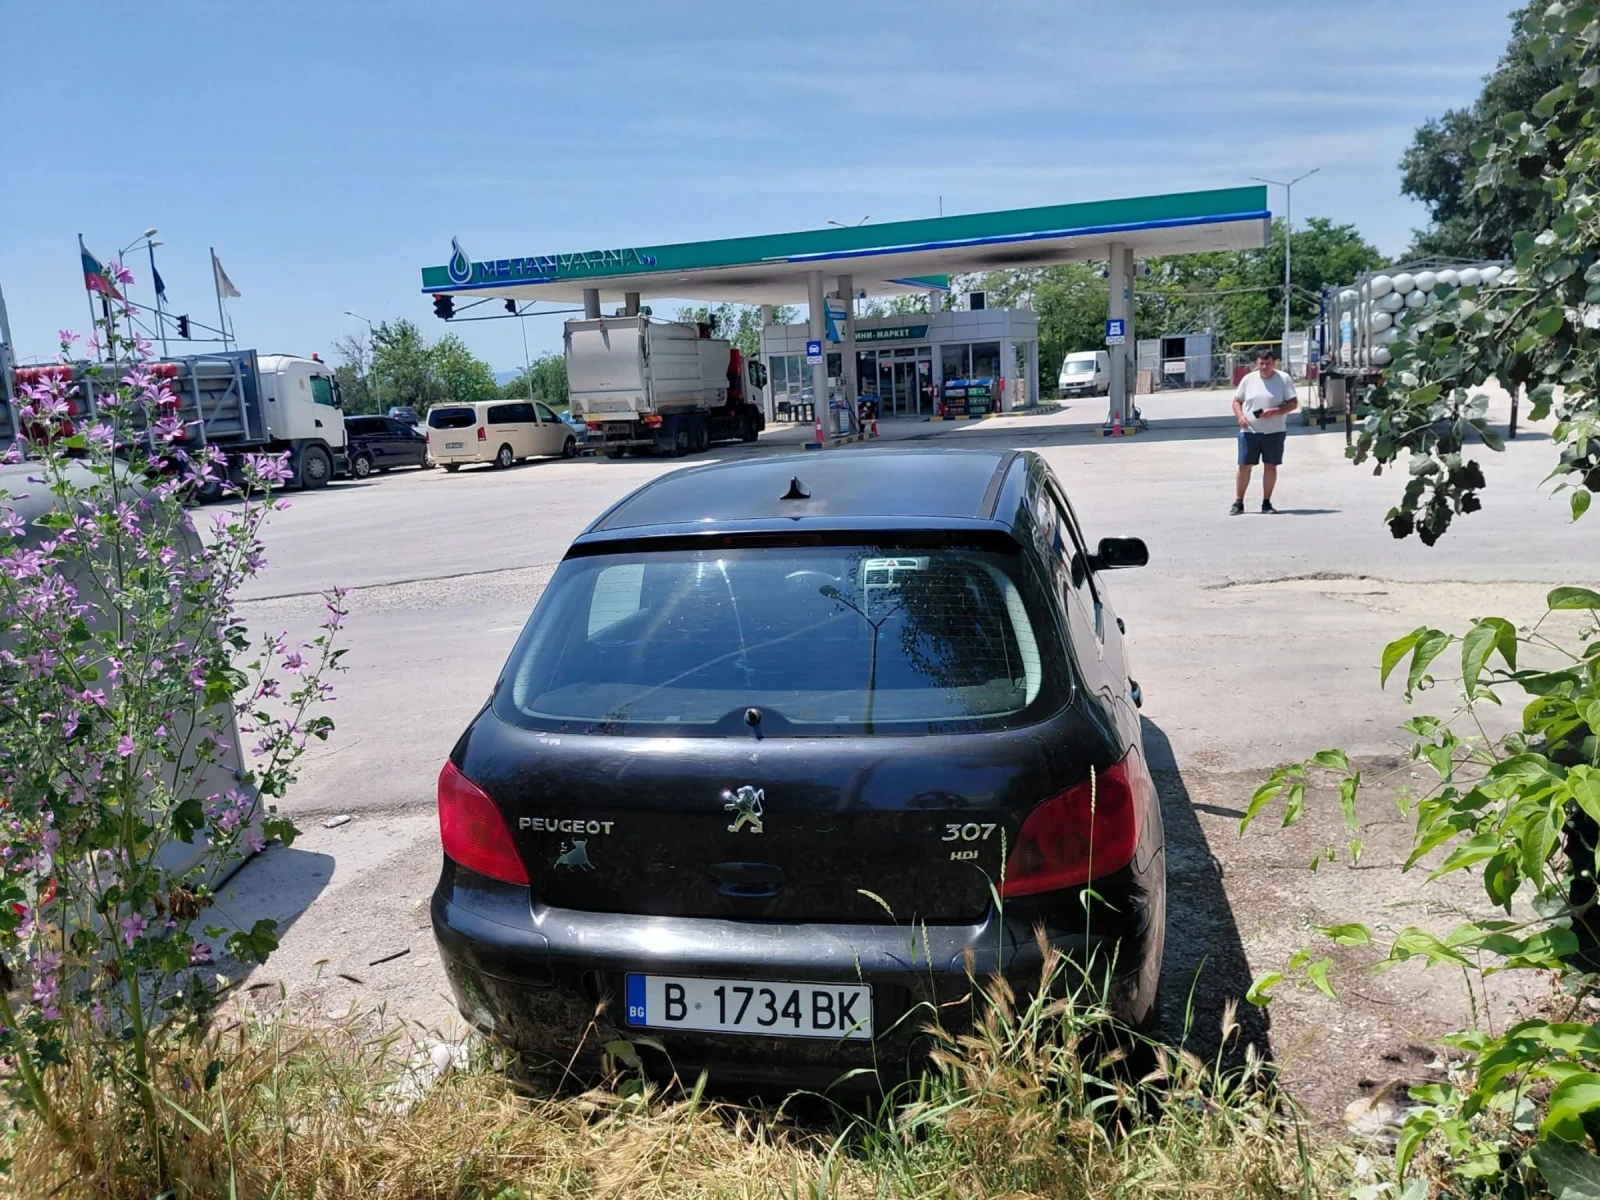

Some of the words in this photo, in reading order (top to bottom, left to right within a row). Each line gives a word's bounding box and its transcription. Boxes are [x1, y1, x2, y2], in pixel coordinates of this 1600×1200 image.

[518, 817, 615, 835] PEUGEOT
[941, 823, 997, 841] 307
[629, 1005, 645, 1018] BG
[664, 983, 688, 1021] B
[713, 985, 803, 1028] 1734
[811, 991, 863, 1032] BK
